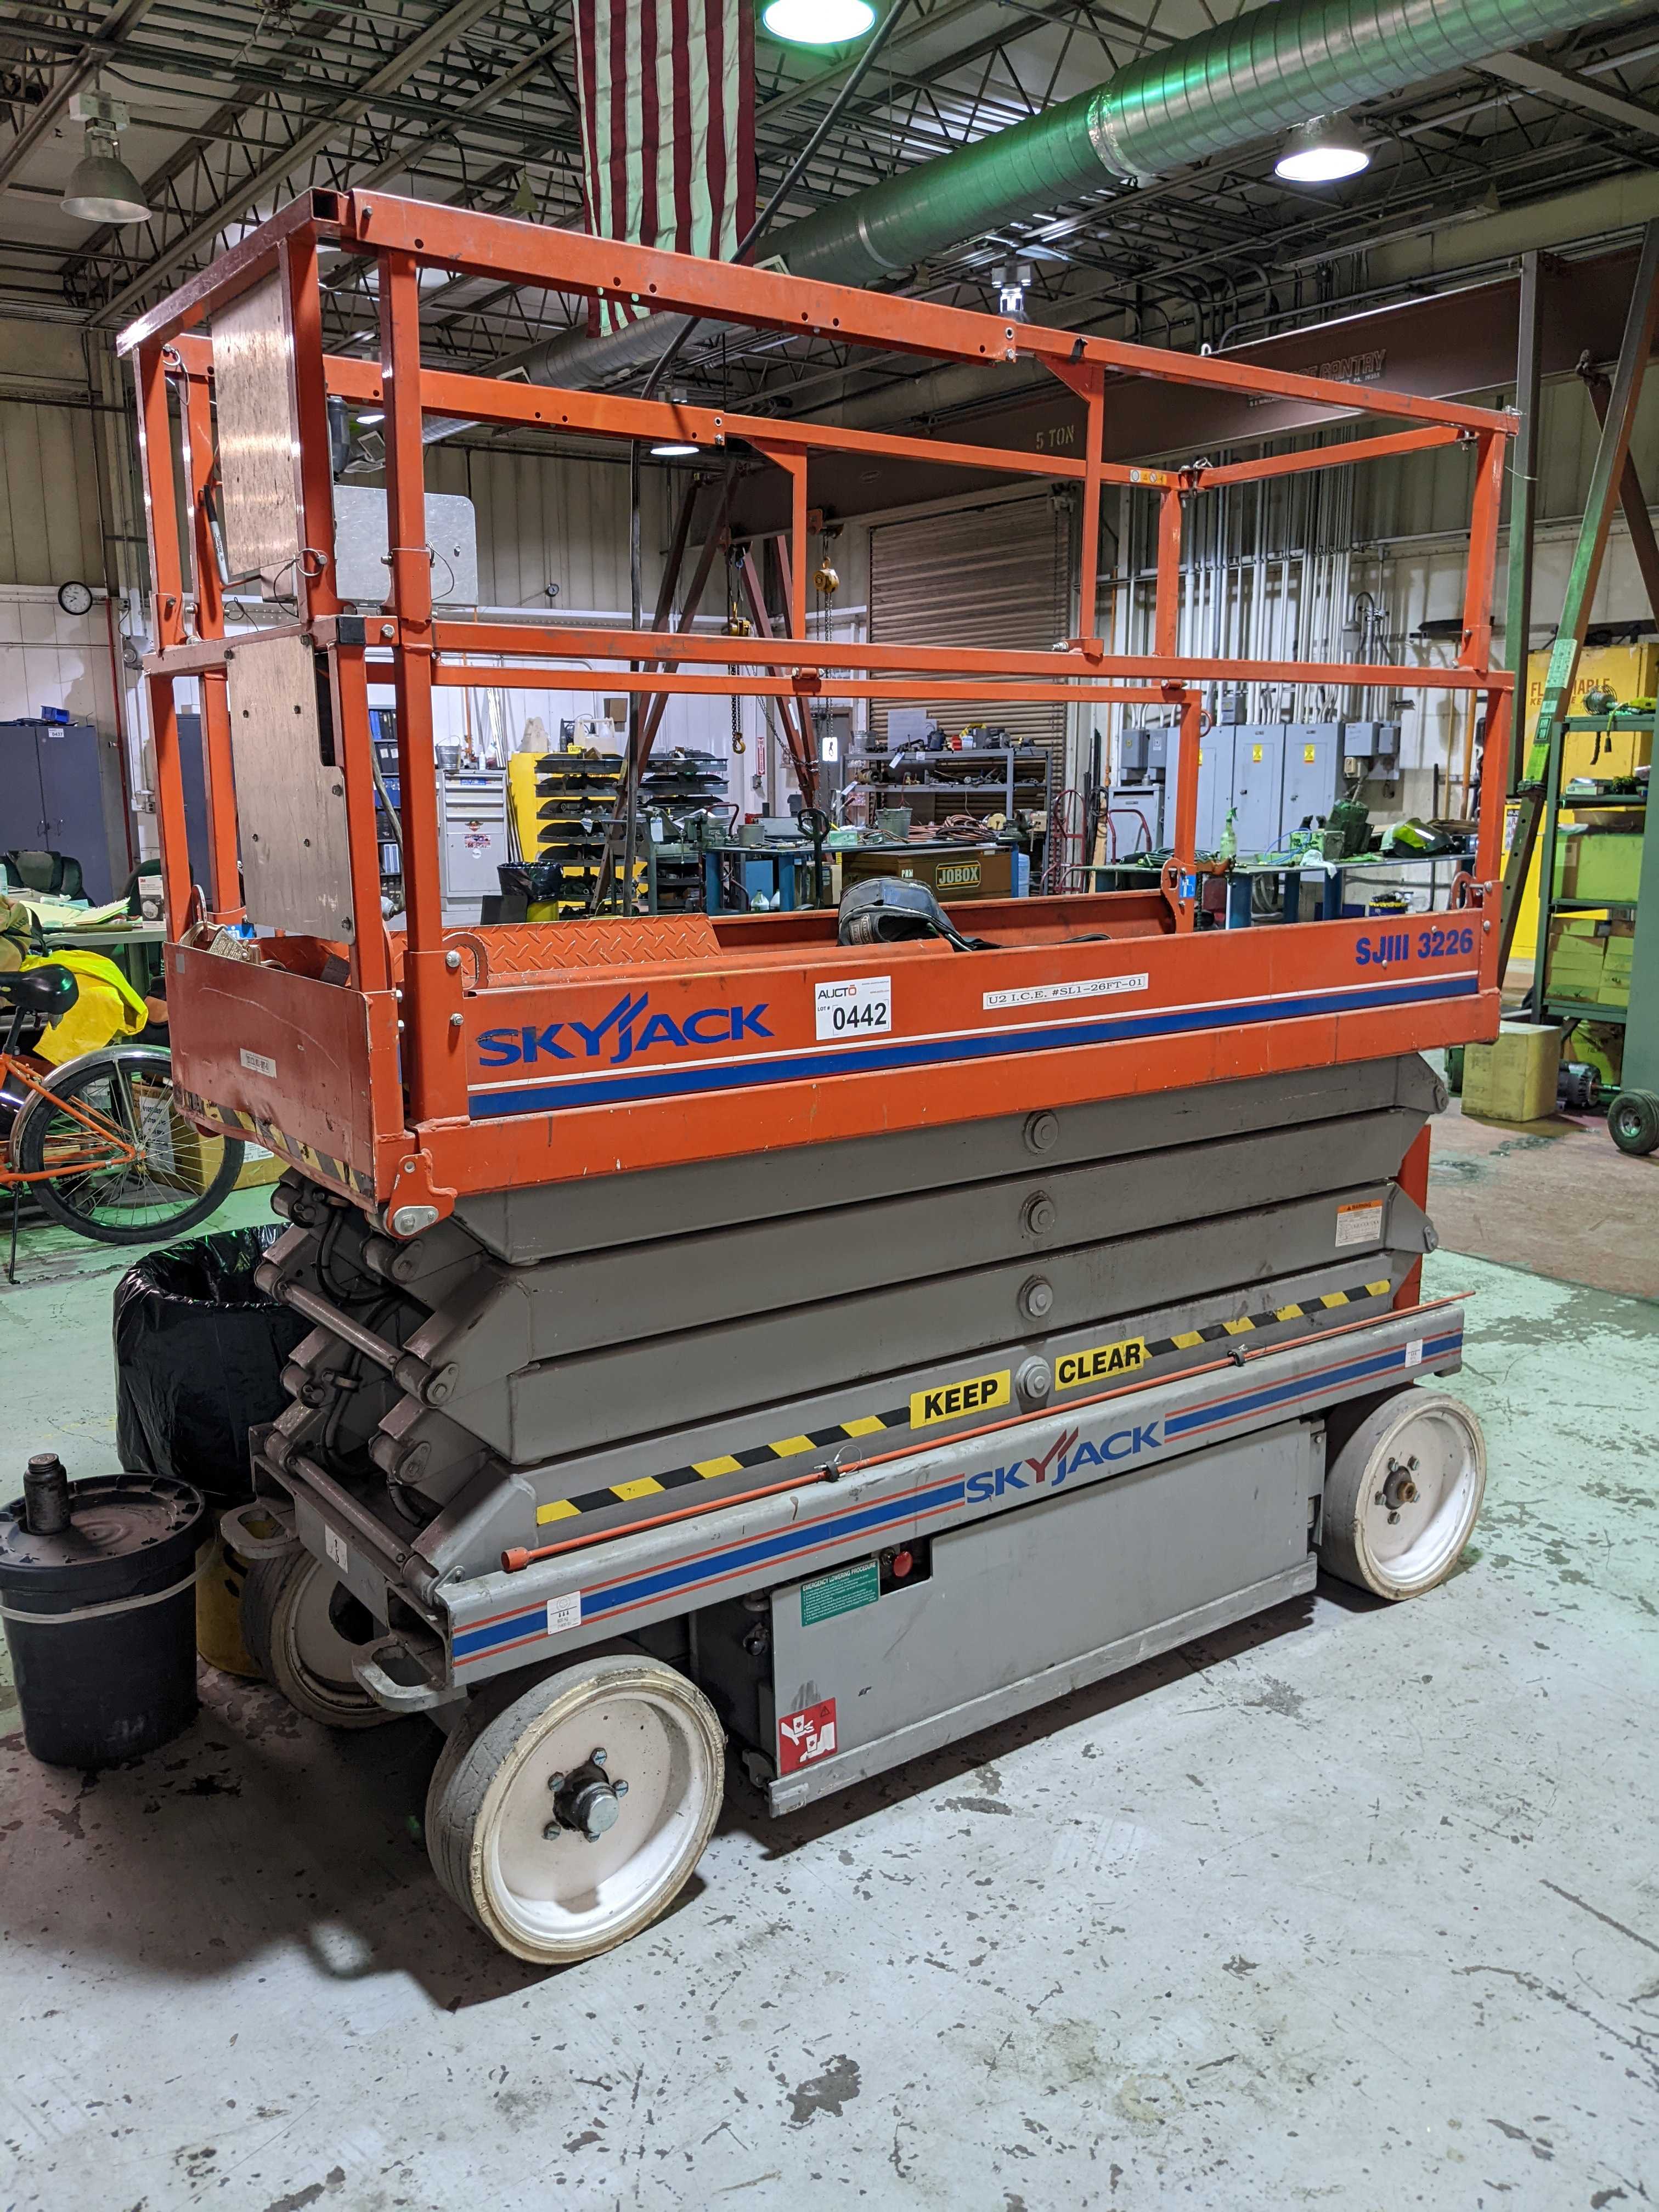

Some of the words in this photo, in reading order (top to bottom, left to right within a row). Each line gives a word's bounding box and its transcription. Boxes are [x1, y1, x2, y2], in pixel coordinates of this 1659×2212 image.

[1319, 349, 1386, 381] GANTRY
[1036, 432, 1043, 449] 5
[1048, 425, 1074, 448] TON
[1530, 678, 1610, 697] FLABLE
[939, 866, 979, 884] JOBOX
[1356, 934, 1409, 966] SJIII
[1418, 928, 1474, 958] 3226
[989, 995, 1007, 1005] U2
[1011, 990, 1047, 1001] I.C.E.
[476, 991, 775, 1067] SKYJACK
[833, 1002, 887, 1030] 0442
[1059, 1343, 1141, 1384] CLEAR
[924, 1379, 998, 1419] KEEP
[966, 1420, 1163, 1503] SKYJACK
[803, 1579, 828, 1591] EMERGENCY
[829, 1571, 851, 1582] LOWERING
[851, 1561, 876, 1575] PROCEDURE
